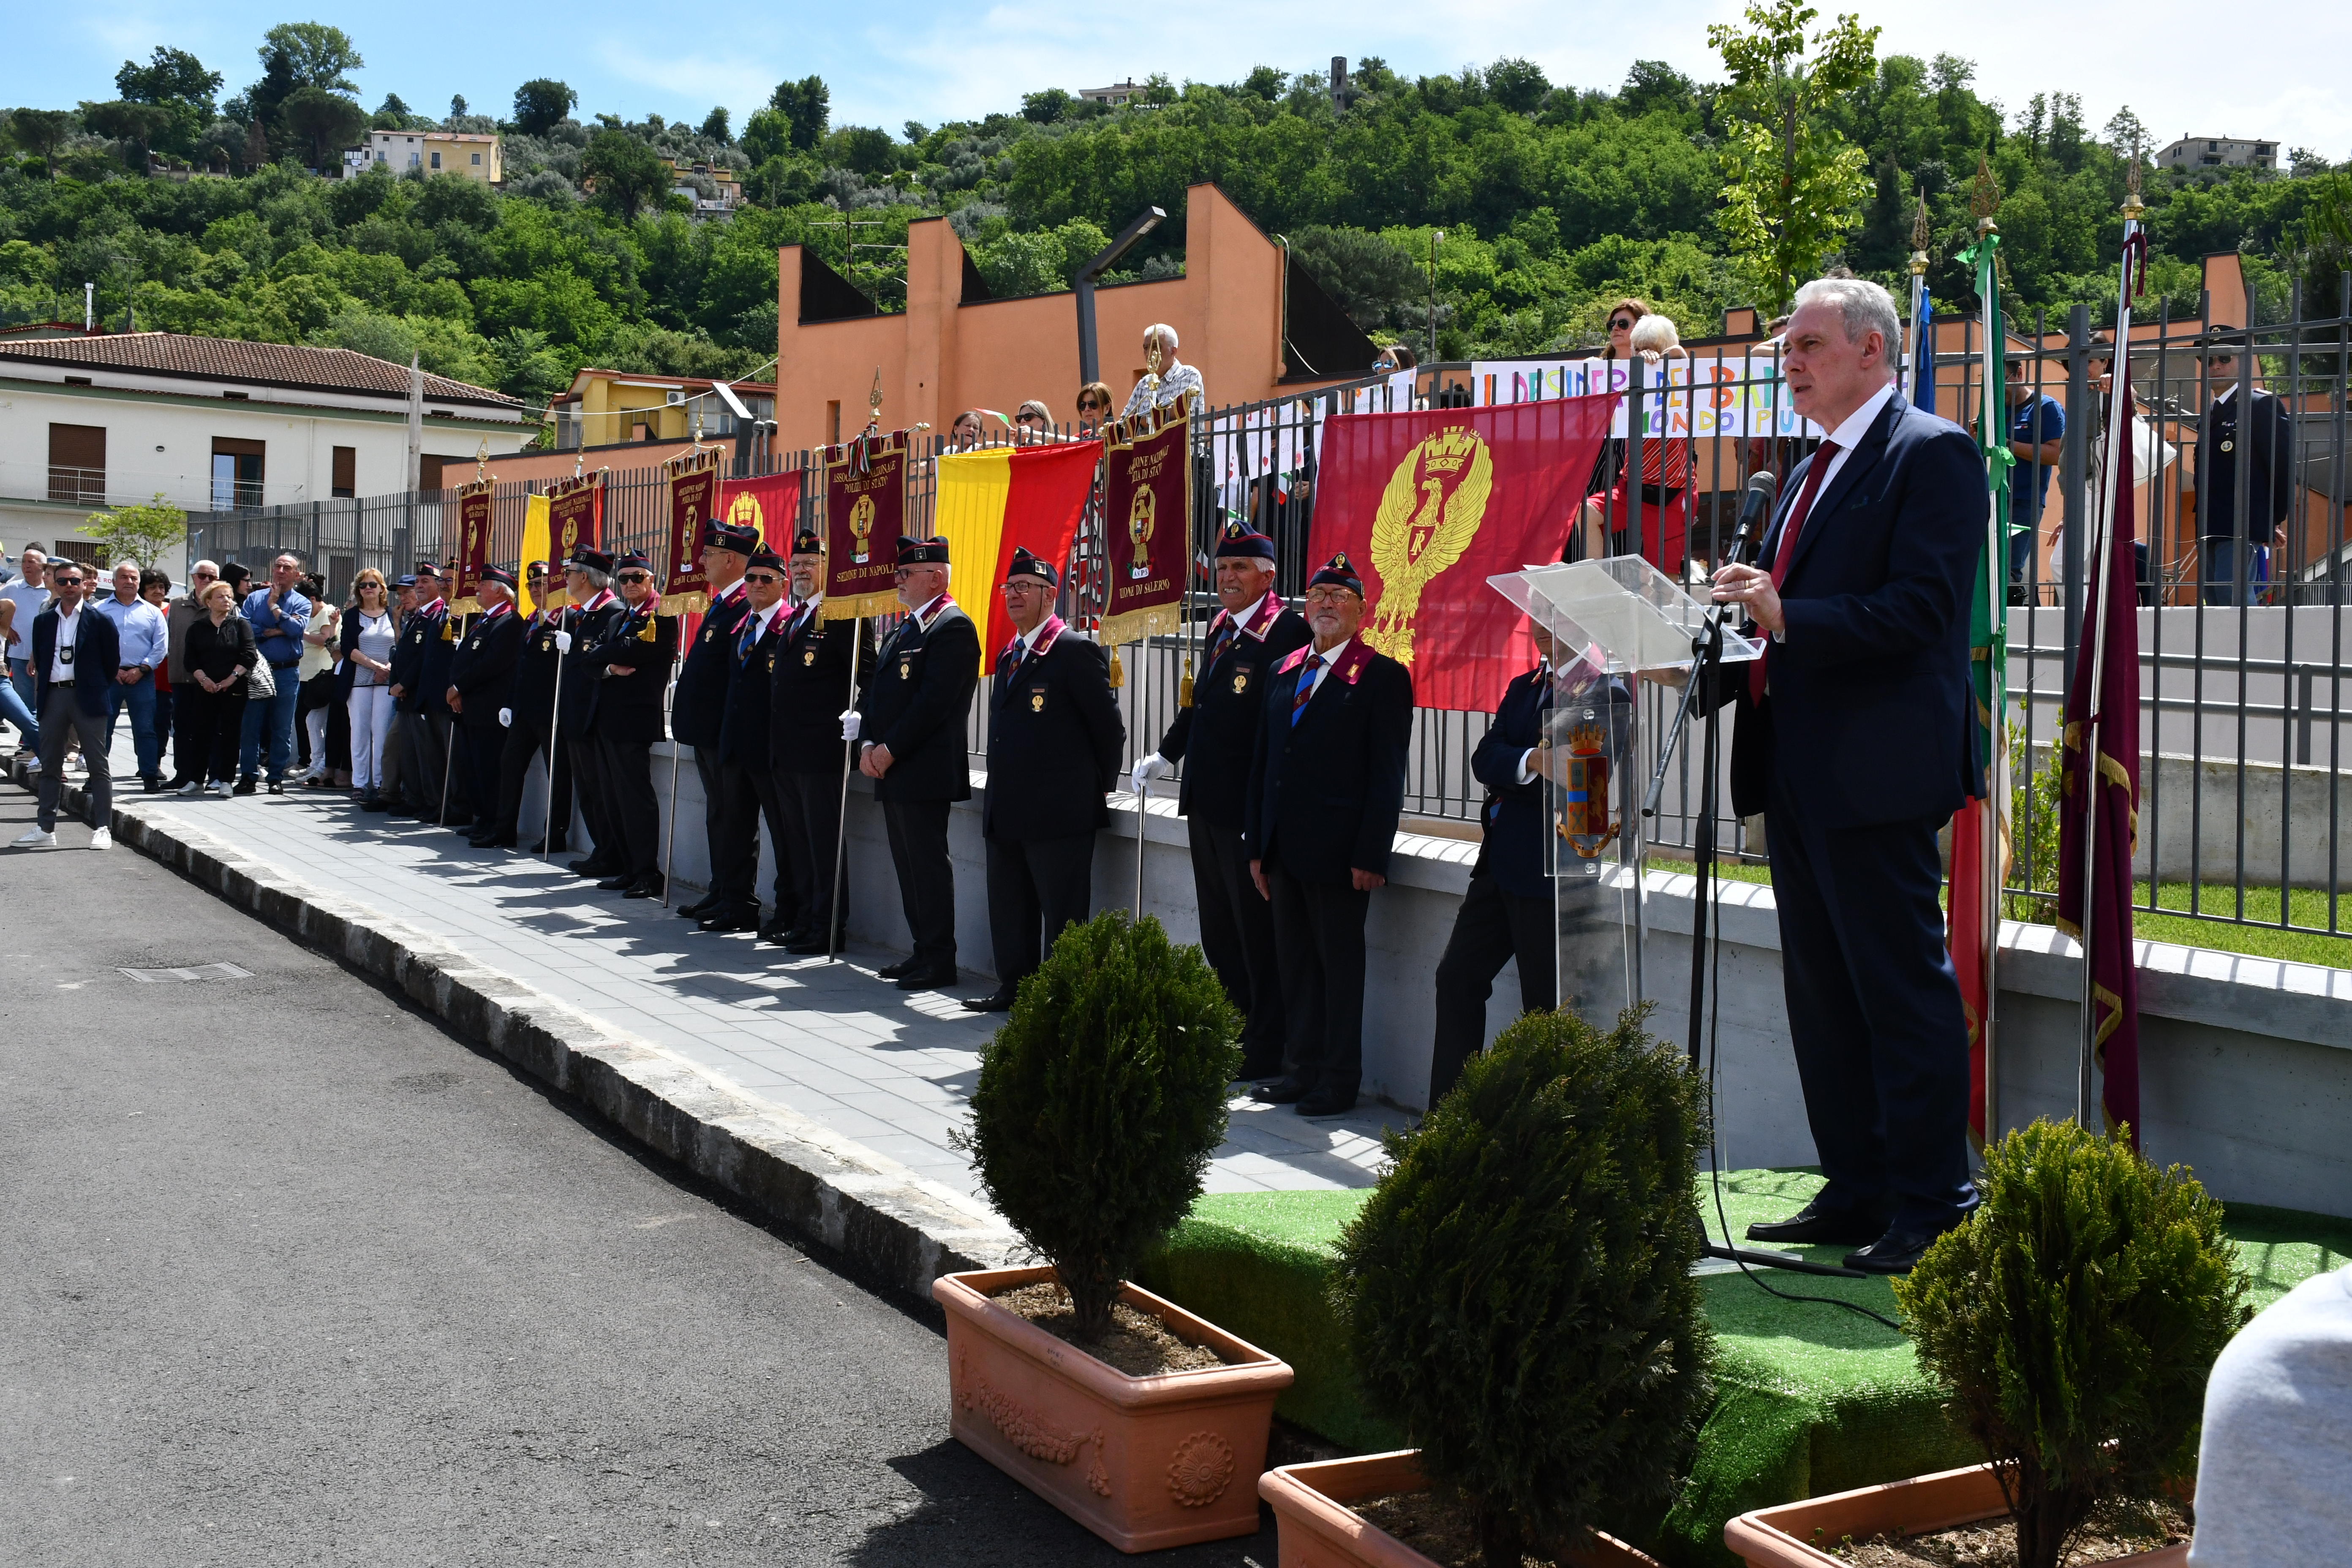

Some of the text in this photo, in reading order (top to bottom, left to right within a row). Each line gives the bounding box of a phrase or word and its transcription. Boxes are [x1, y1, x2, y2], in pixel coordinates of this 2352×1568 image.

[863, 480, 870, 491] DI
[858, 567, 868, 578] DI
[869, 563, 895, 577] NAPOLI
[1133, 569, 1148, 578] ANPS
[1135, 584, 1143, 596] DI
[1144, 578, 1170, 594] SALERNO
